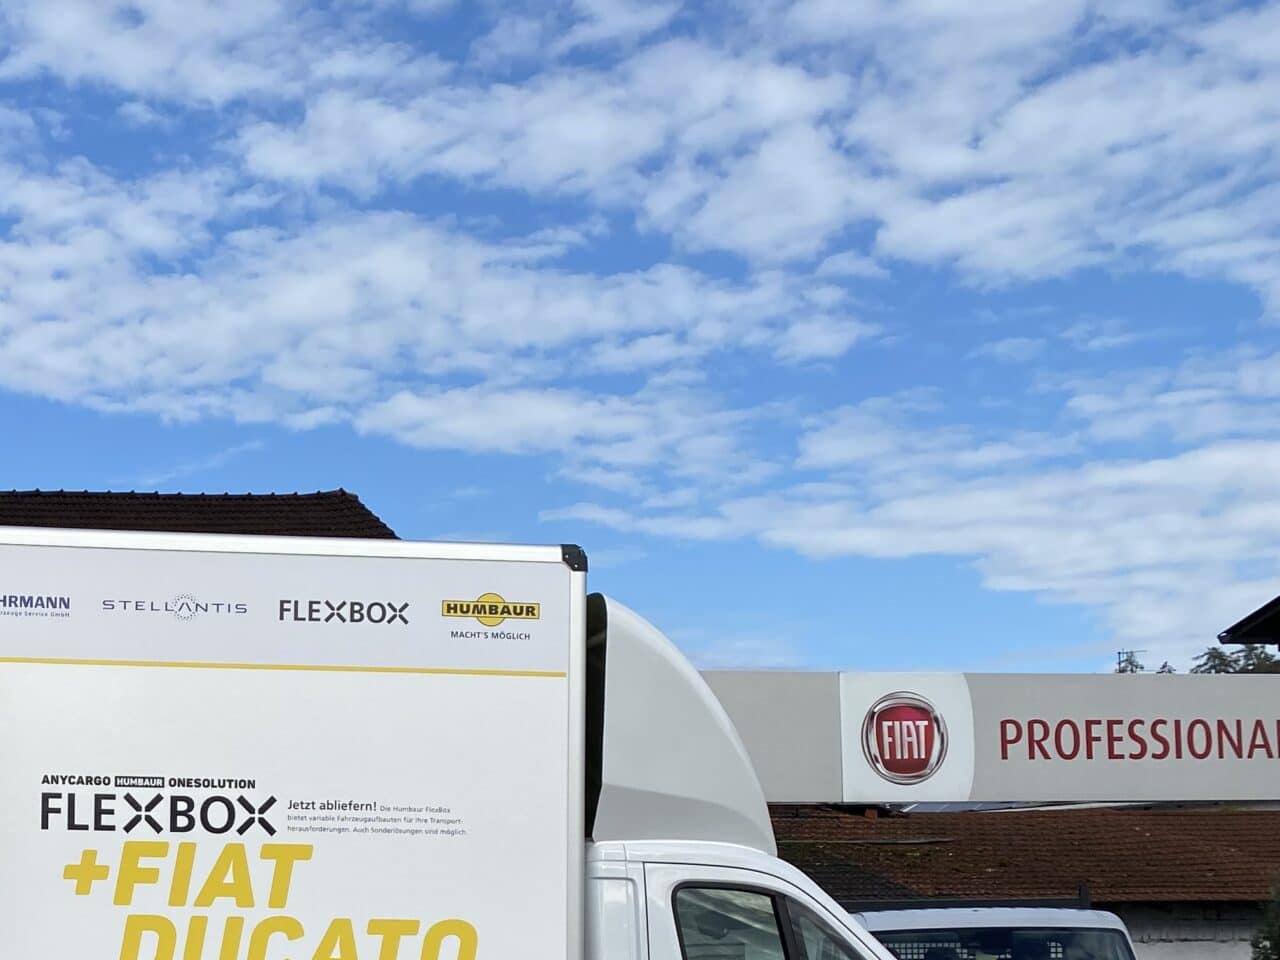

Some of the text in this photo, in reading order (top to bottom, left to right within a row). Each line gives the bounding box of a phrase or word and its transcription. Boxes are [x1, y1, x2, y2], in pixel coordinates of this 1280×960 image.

[102, 599, 248, 614] STELLANTIS
[278, 599, 409, 625] FLEXBOX
[445, 602, 536, 617] HUMBAUR
[450, 630, 530, 641] MACHT'S MÖGLICH
[882, 719, 929, 761] FIAT
[1000, 718, 1280, 760] PROFESSIONA
[41, 775, 256, 789] ANYCARGO HUMBAUR ONESOLUTION
[287, 799, 316, 810] Jetzt
[319, 800, 377, 811] abliefern!
[40, 792, 278, 836] FLEXBOX
